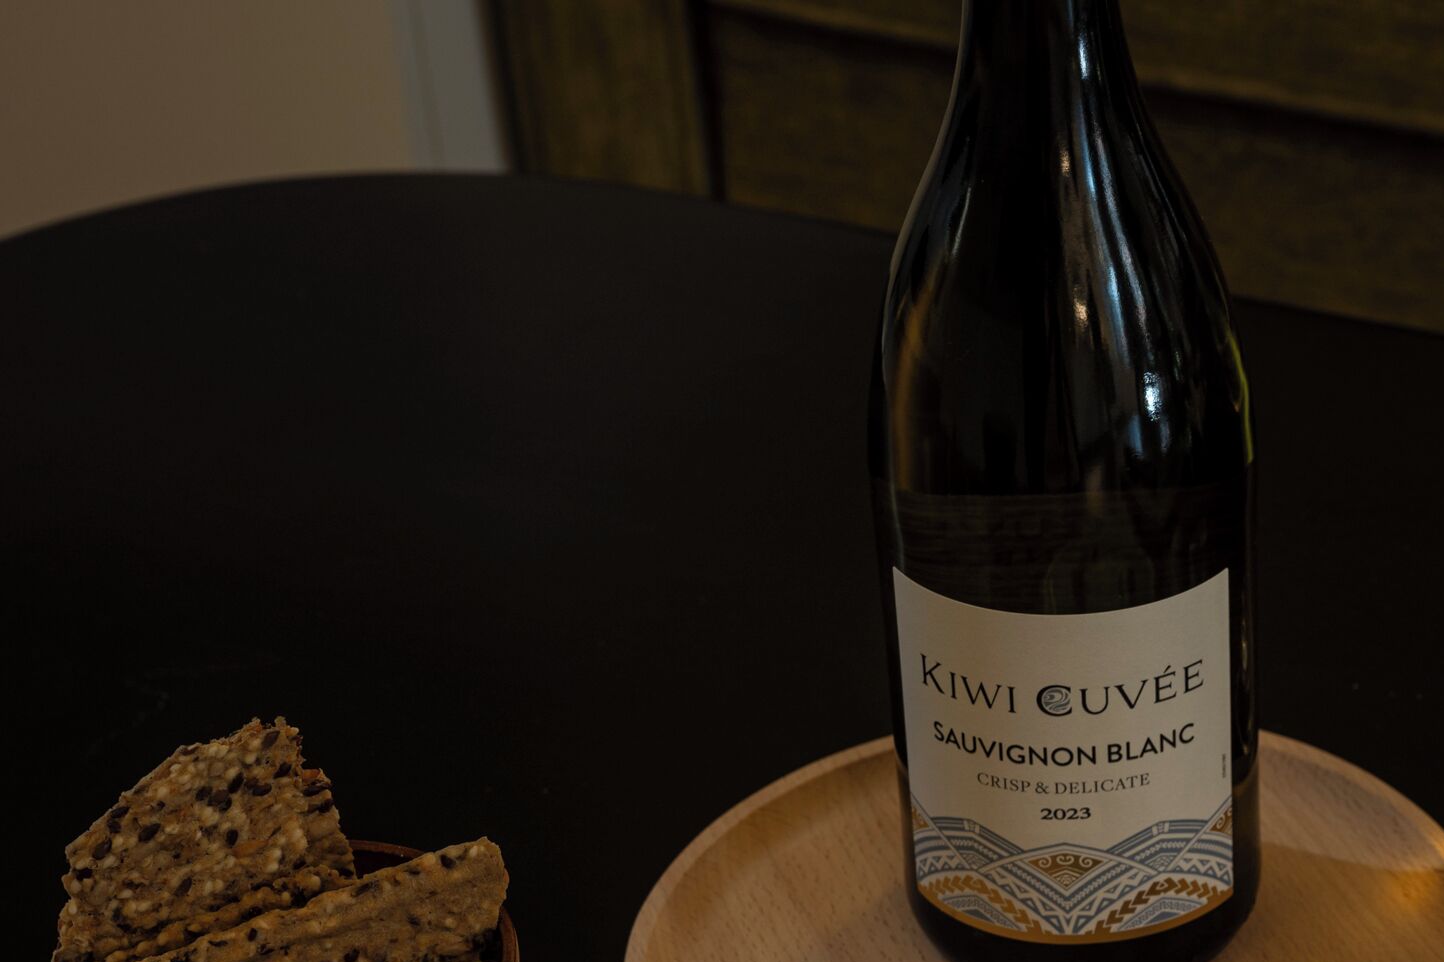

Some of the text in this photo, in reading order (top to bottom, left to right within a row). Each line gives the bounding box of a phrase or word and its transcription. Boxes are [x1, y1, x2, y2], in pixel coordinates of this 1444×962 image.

[920, 653, 1205, 717] KIWI CUVÉE
[933, 720, 1195, 767] SAUVIGNON BLANC
[977, 772, 1151, 795] CRISP & DELICATE
[1040, 806, 1092, 820] 2023
